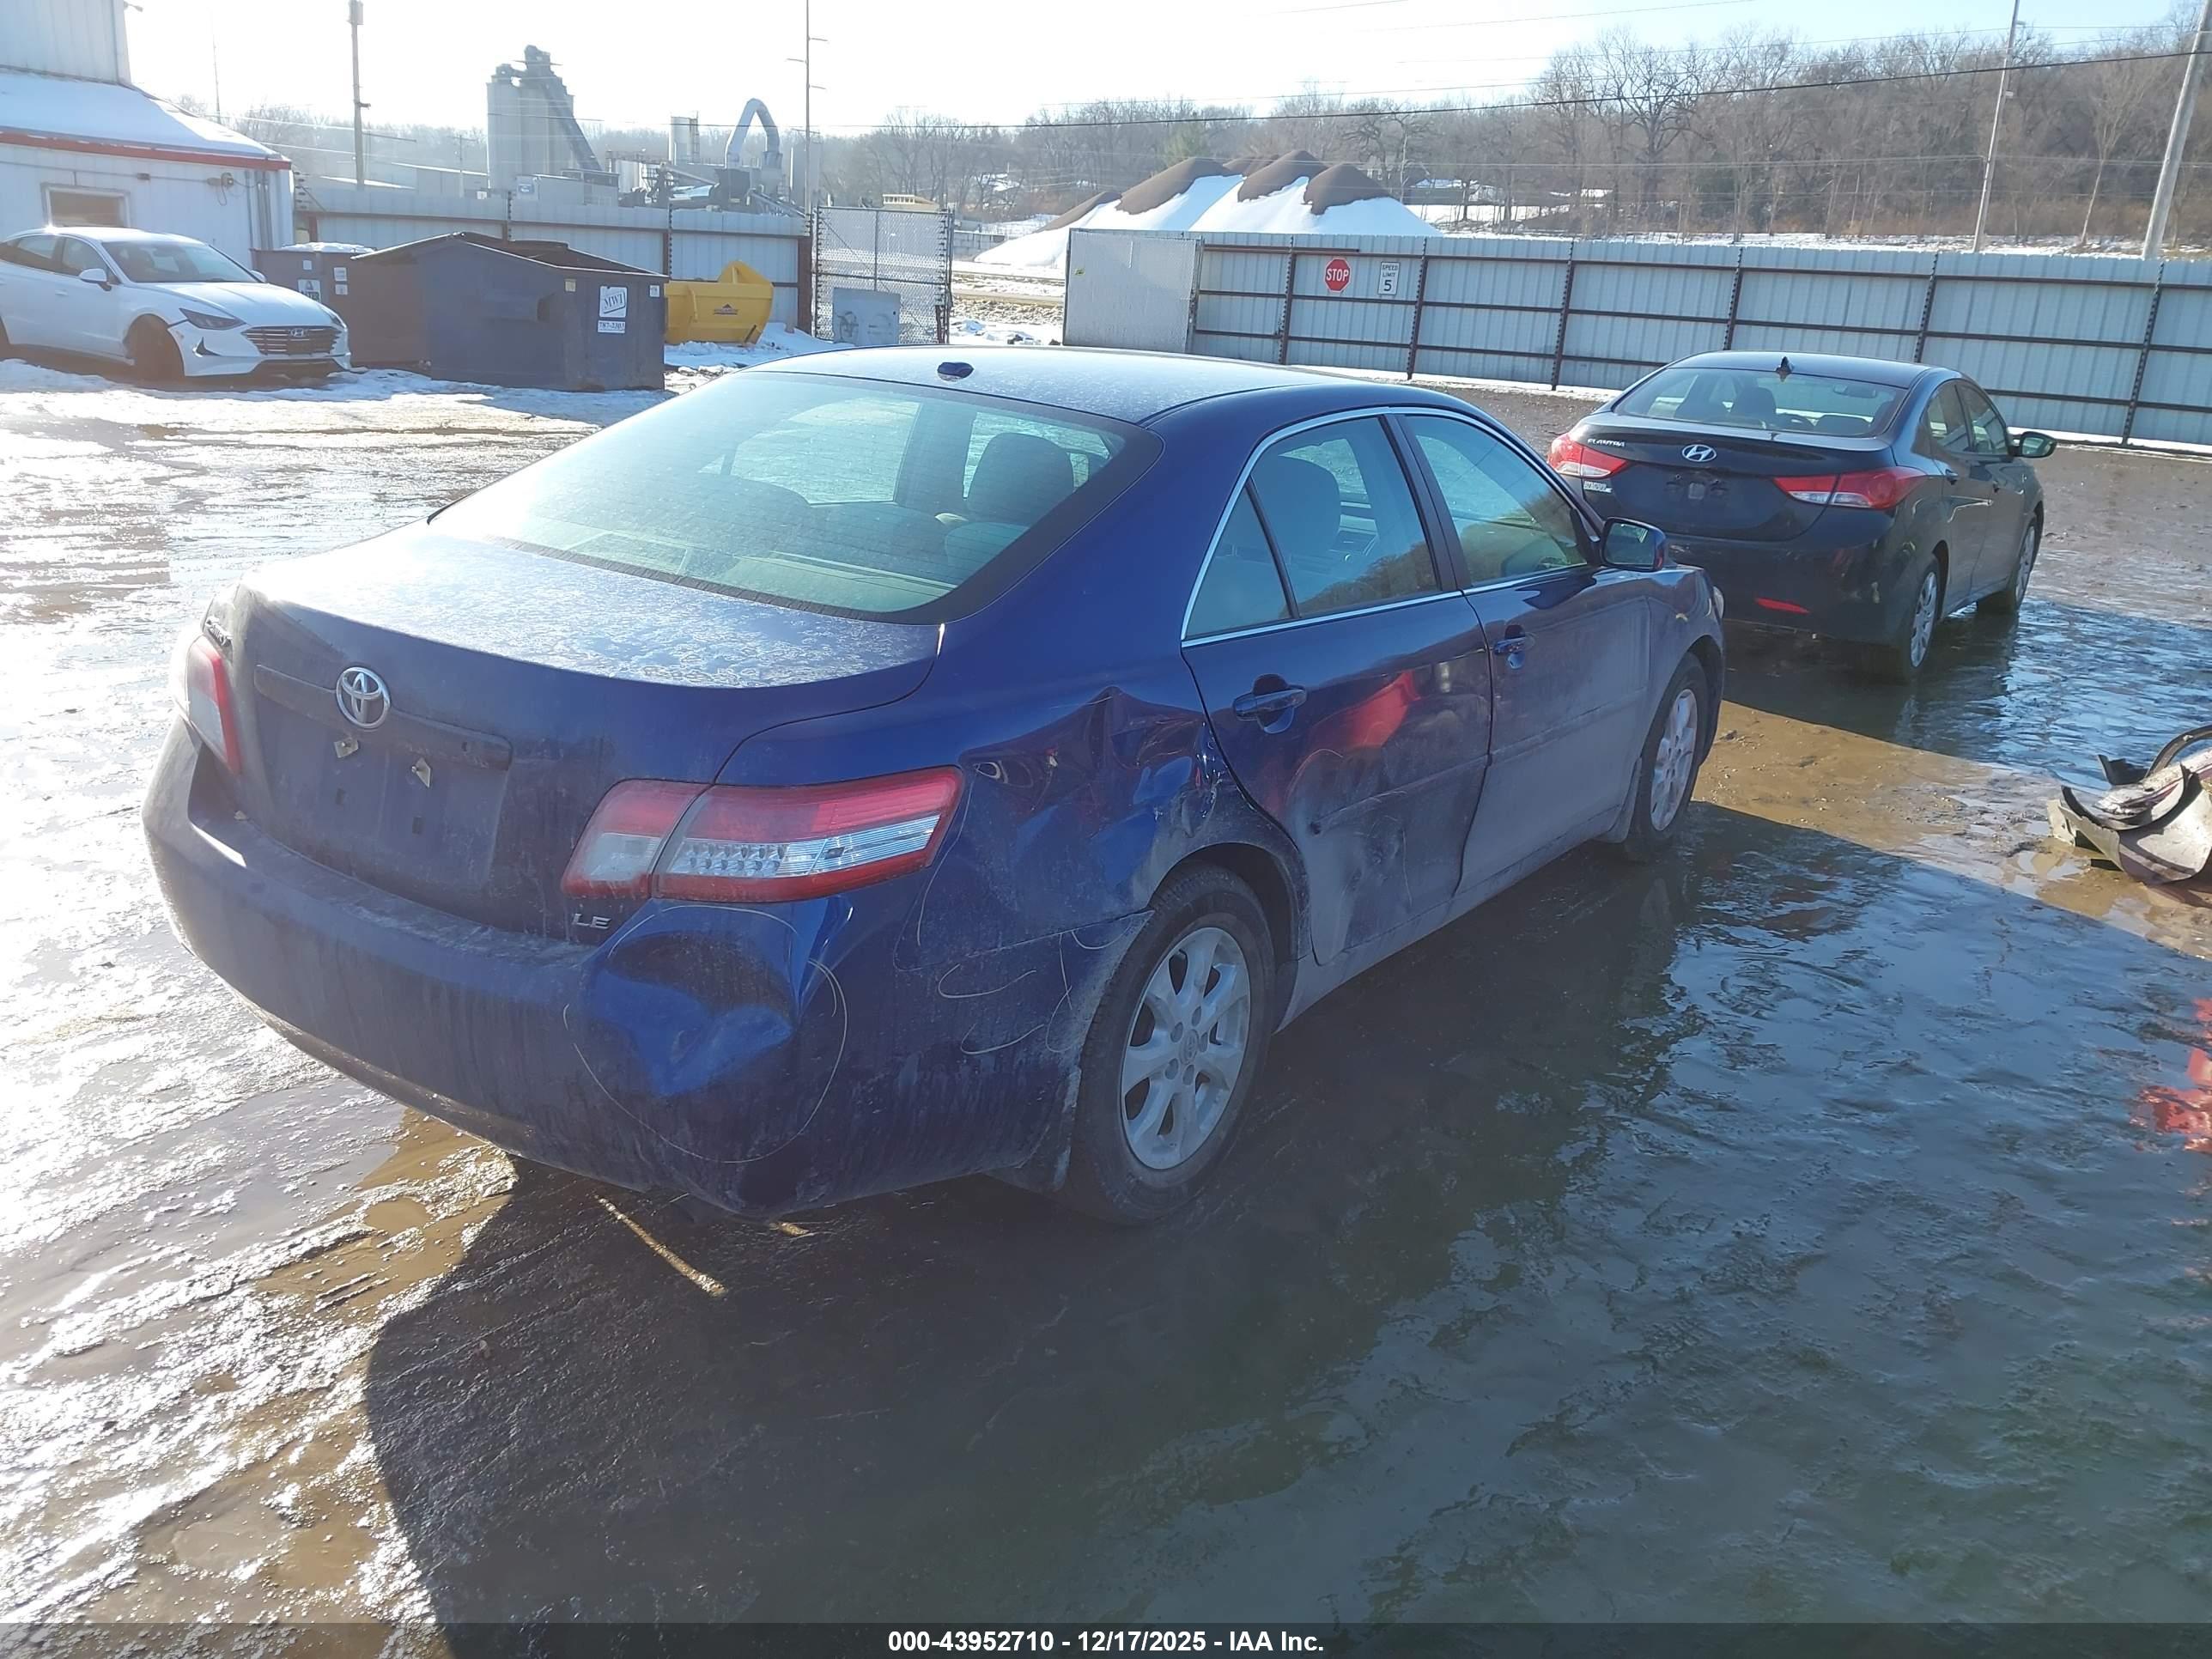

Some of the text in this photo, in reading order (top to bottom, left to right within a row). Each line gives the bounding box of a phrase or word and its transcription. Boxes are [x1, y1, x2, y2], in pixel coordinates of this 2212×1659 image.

[1326, 269, 1349, 282] STOP
[1383, 279, 1392, 292] 5
[605, 294, 623, 308] MWI
[1587, 438, 1626, 447] ELANTRA
[572, 913, 611, 929] LE
